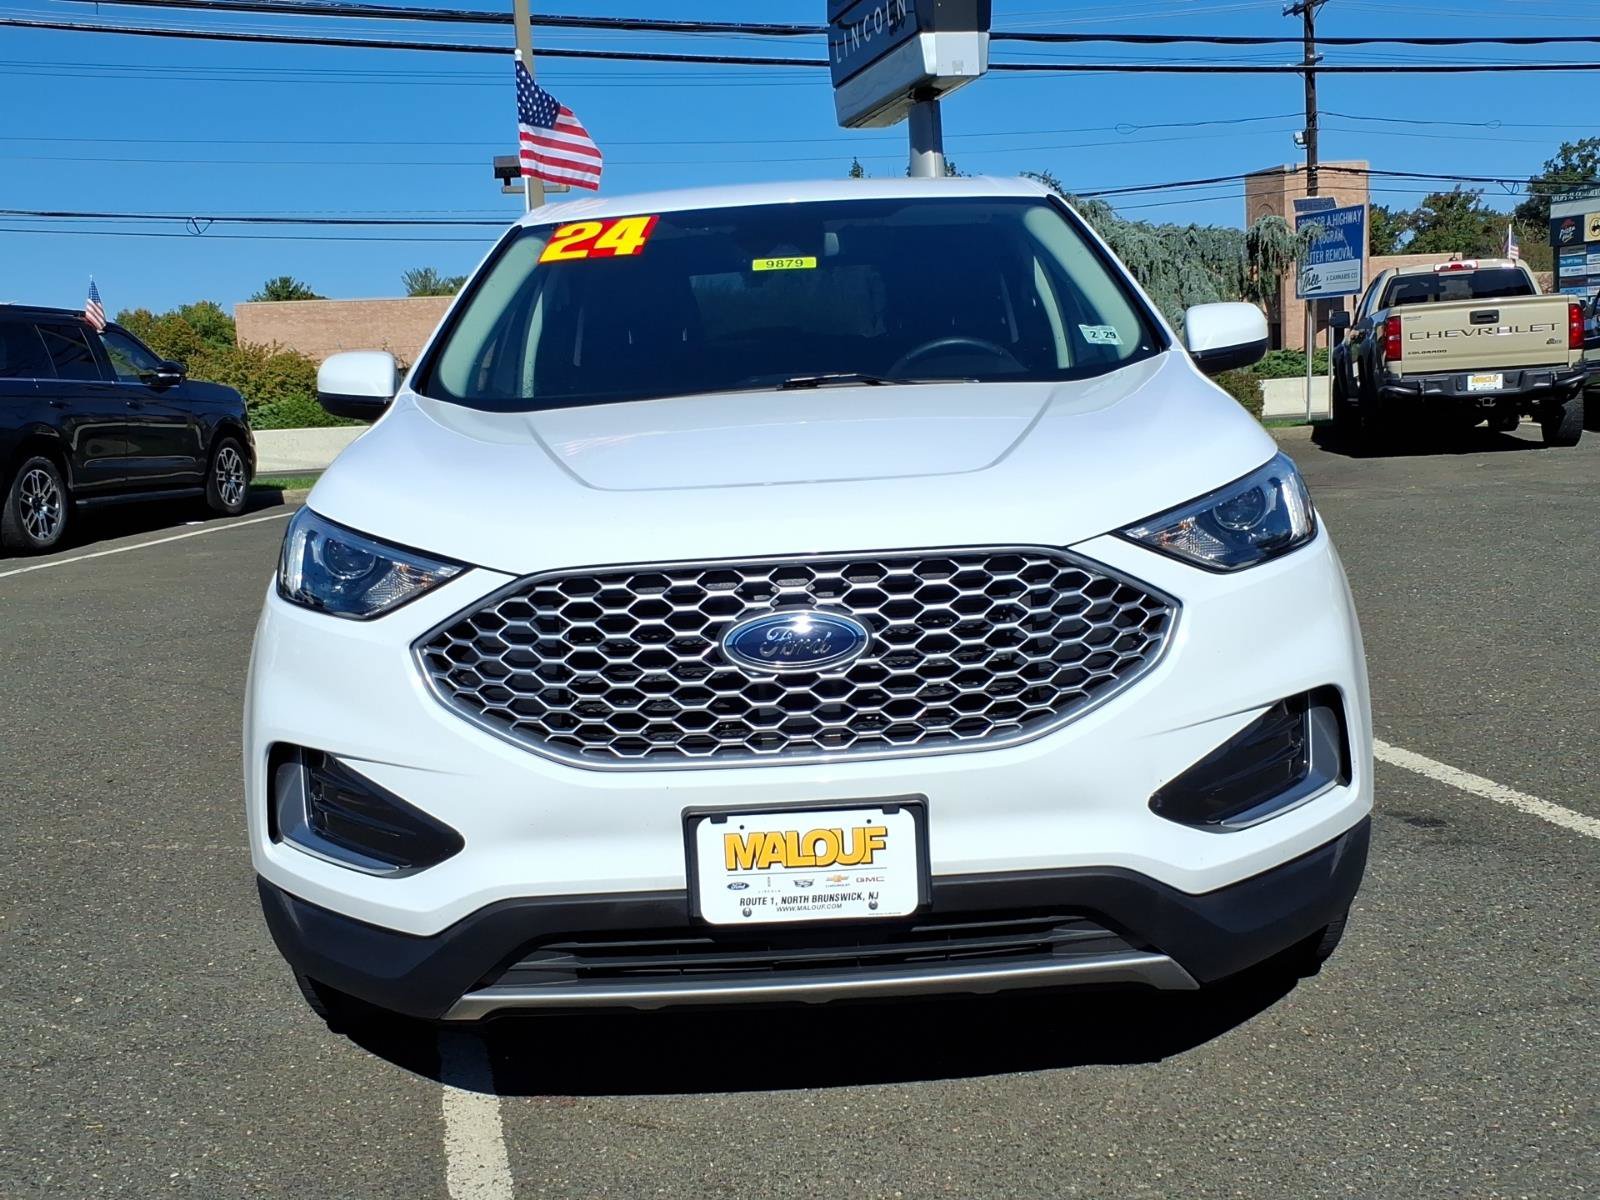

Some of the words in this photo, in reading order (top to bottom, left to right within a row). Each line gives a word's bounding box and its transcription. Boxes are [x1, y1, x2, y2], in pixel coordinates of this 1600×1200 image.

[835, 0, 906, 64] LINCOLN
[1333, 210, 1362, 225] HIGHWAY
[539, 216, 652, 262] 24
[1326, 247, 1354, 261] REMOVAL
[766, 258, 804, 269] 9879
[1103, 331, 1116, 339] 29
[1409, 322, 1561, 341] CHEVROLET
[759, 626, 832, 657] Ford
[724, 826, 888, 871] MALOUF
[739, 896, 768, 907] ROUTE
[781, 895, 809, 904] NORTH
[812, 891, 865, 903] BRUNSWICK,
[868, 891, 879, 900] NJ
